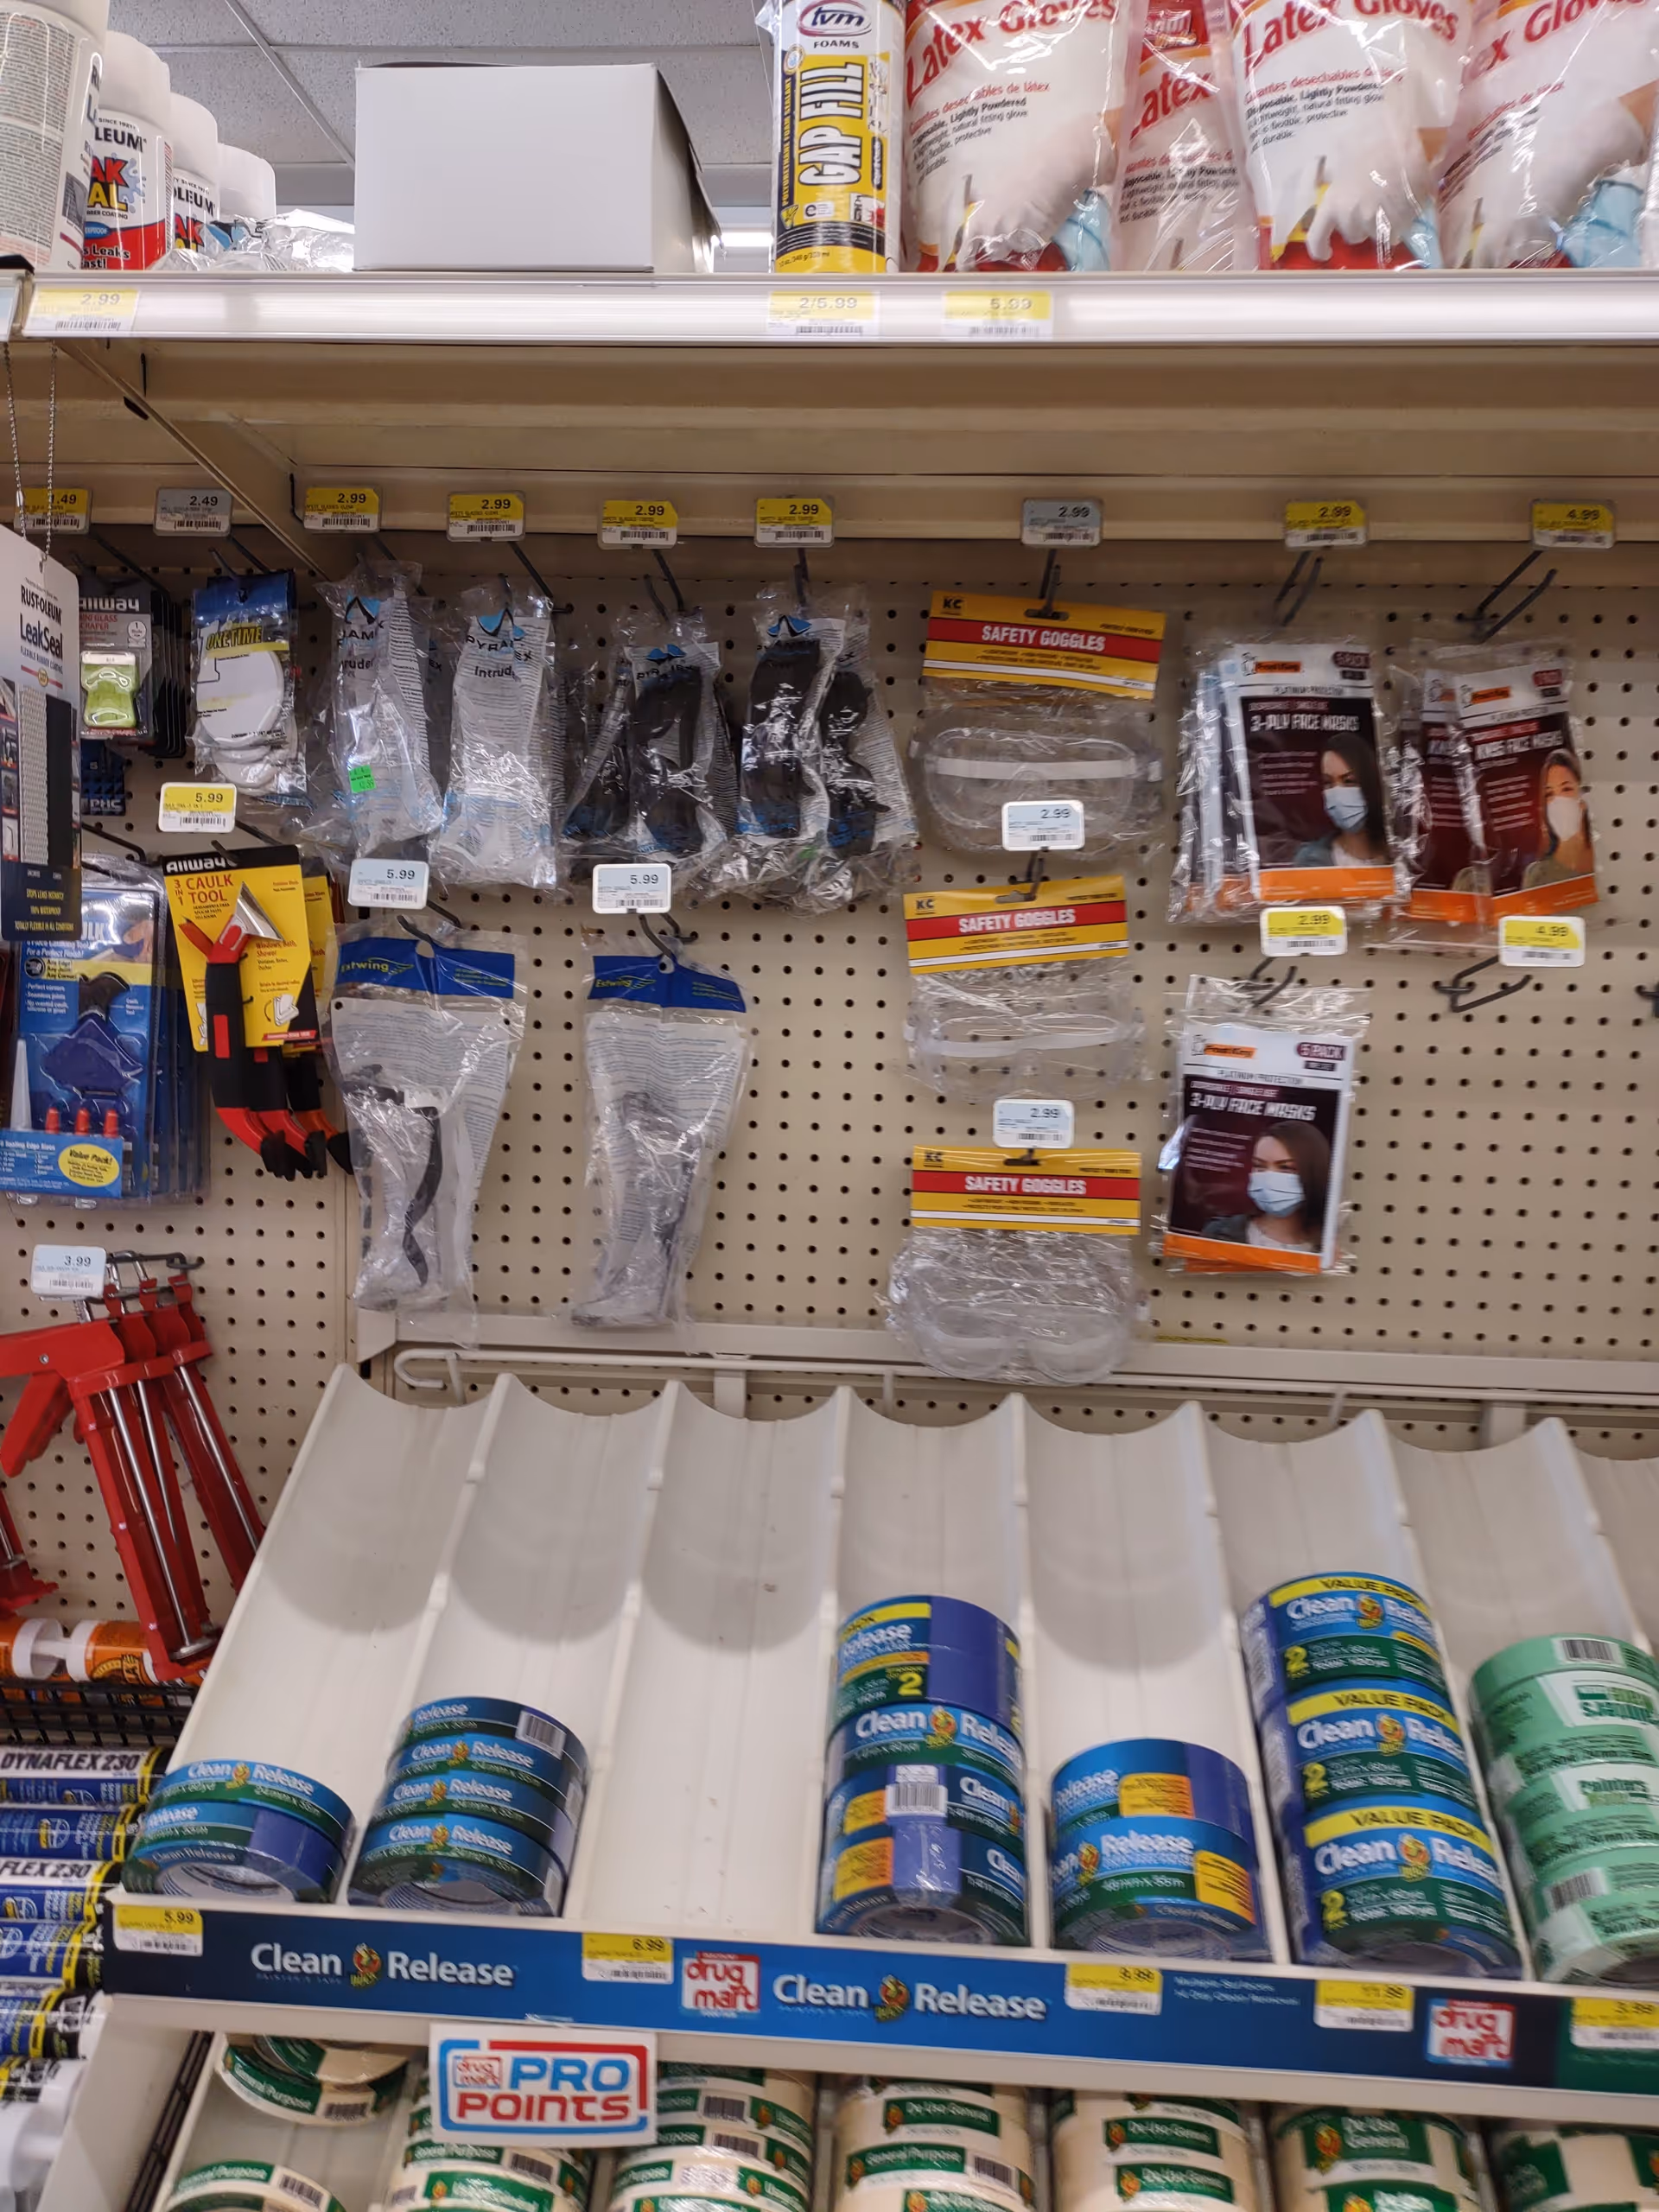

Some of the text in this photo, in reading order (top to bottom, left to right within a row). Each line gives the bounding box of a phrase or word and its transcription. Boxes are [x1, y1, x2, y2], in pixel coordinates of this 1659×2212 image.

[813, 39, 860, 49] FOAMS
[1243, 0, 1332, 79] Latex
[907, 16, 985, 107] Latex
[798, 61, 864, 121] FILL
[798, 124, 863, 187] GAP
[92, 245, 130, 259] Leaks
[81, 293, 121, 306] 2.99
[798, 296, 858, 309] 2/5.99
[189, 495, 218, 506] 2.49
[337, 493, 366, 504] 2.99
[481, 499, 511, 510] 2.99
[635, 505, 664, 517] 2.99
[789, 504, 818, 515] 2.99
[1058, 505, 1091, 519] 2.99
[21, 584, 62, 626] RUST-OLEUM
[943, 596, 964, 609] KC
[20, 613, 63, 661] LeakSeal
[982, 625, 1107, 652] SAFETY GOGGLES
[1291, 714, 1319, 730] FACE
[195, 792, 223, 804] 5.99
[1039, 807, 1071, 820] 2.99
[166, 857, 226, 874] Allway
[386, 868, 416, 880] 5.99
[174, 879, 181, 889] 3
[186, 874, 234, 891] CAULK
[629, 874, 659, 886] 5.99
[177, 897, 184, 906] 1
[188, 889, 228, 905] TOOL
[915, 897, 936, 910] KC
[958, 908, 1077, 934] SAFETY GOGGLES
[1030, 1108, 1060, 1119] 2.99
[1229, 1098, 1262, 1117] FACE
[1264, 1103, 1318, 1122] MASKS
[924, 1151, 944, 1164] KC
[965, 1176, 1087, 1195] SAFETY GOGGLES
[64, 1255, 92, 1268] 3.99
[1320, 1579, 1381, 1592] VALUE
[1286, 1597, 1357, 1621] Clean
[898, 1672, 924, 1697] 2
[1333, 1694, 1400, 1708] VALUE
[855, 1710, 927, 1738] Clean
[1296, 1718, 1376, 1749] Clean
[1, 1751, 140, 1771] DYNAFLEX 230
[411, 1740, 536, 1769] Clean Release
[188, 1760, 315, 1796] Clean Release
[393, 1777, 513, 1803] Clean Release
[1349, 1809, 1426, 1827] VALUE
[389, 1822, 513, 1856] Clean Release
[1100, 1828, 1195, 1858] Release
[1314, 1838, 1398, 1876] Clean
[0, 1859, 92, 1878] FLEX 230
[164, 1910, 195, 1925] 5.99
[632, 1936, 664, 1952] 6.99
[250, 1942, 515, 1987] Clean Release
[687, 1961, 745, 1986] drug
[695, 1984, 757, 2012] mart
[773, 1974, 1047, 2021] Clean Release
[1433, 2008, 1497, 2034] drug
[1439, 2031, 1512, 2060] mart
[509, 2056, 630, 2092] PRO
[265, 2087, 312, 2110] Purpose
